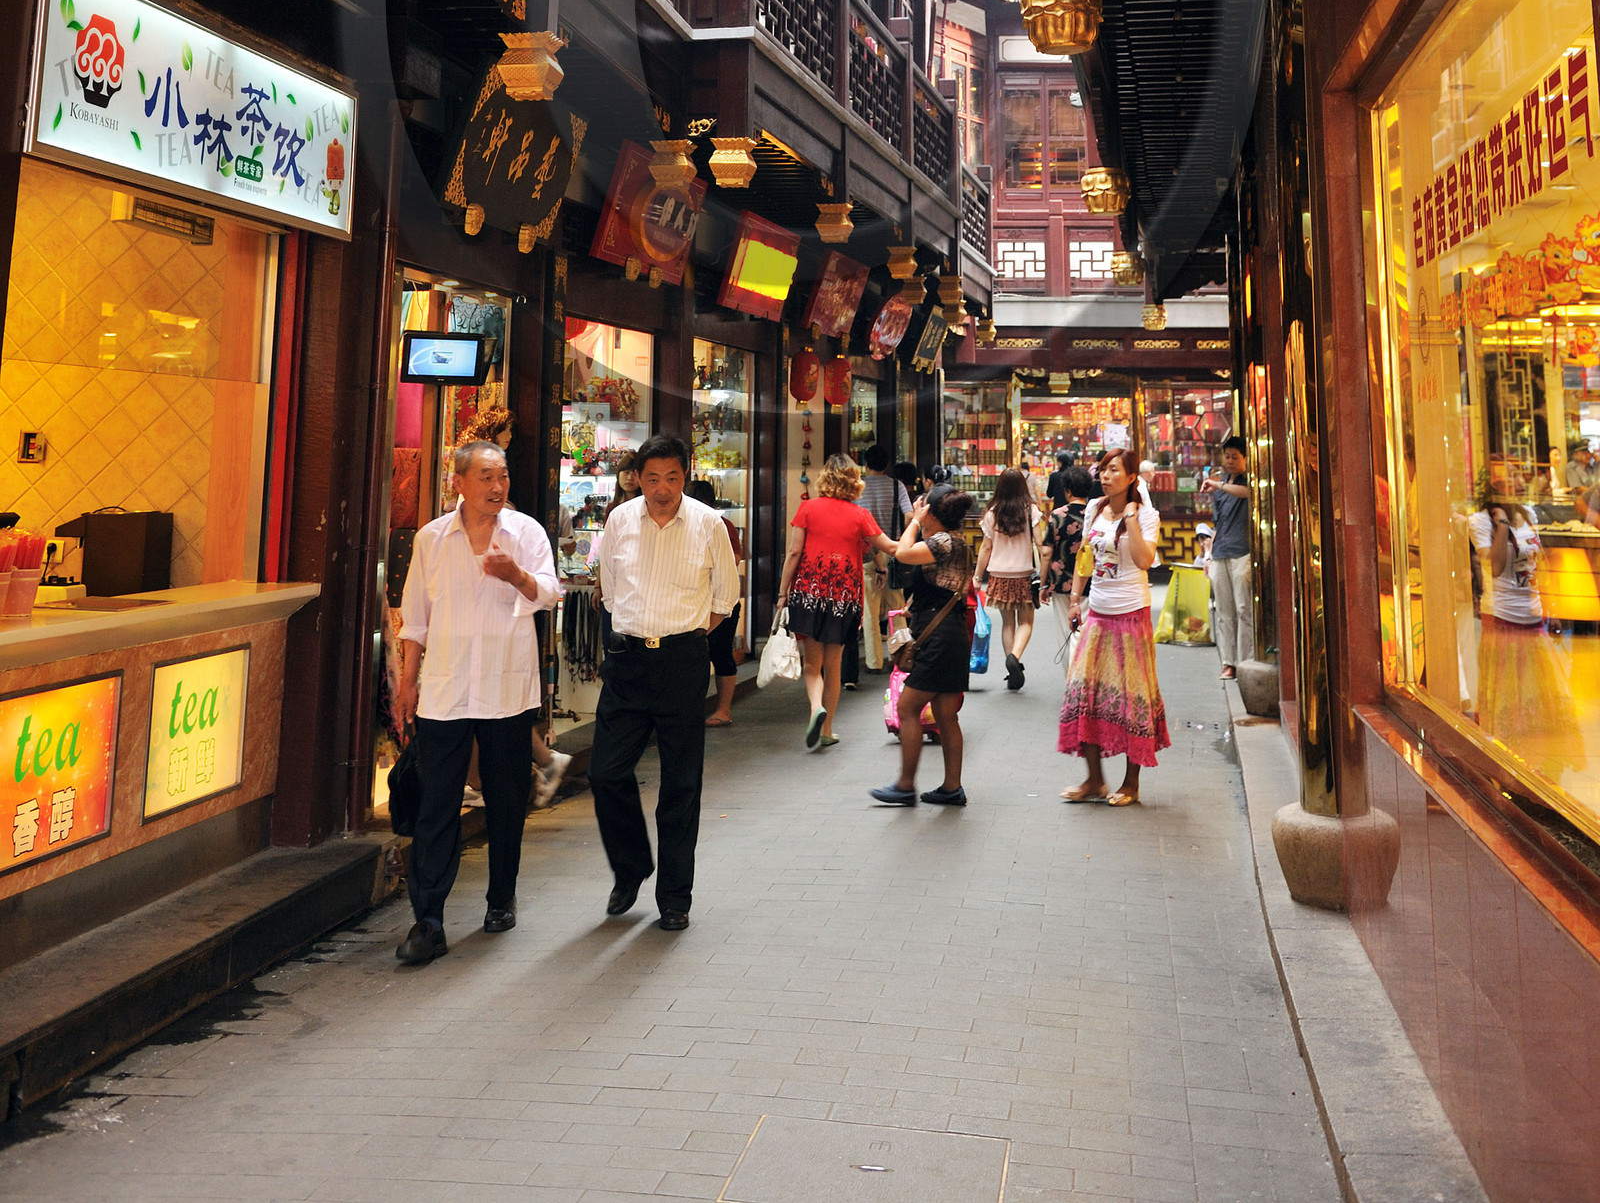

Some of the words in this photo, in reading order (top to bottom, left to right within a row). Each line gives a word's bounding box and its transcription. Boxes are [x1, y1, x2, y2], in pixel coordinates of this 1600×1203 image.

[205, 47, 235, 99] TEA
[144, 67, 305, 187] 小林茶饮
[155, 132, 192, 168] TEA
[313, 100, 340, 136] TEA
[1413, 45, 1594, 269] 老庙黄金给您带来好运气
[168, 680, 220, 739] tea
[14, 714, 82, 783] tea
[12, 786, 76, 858] 香醇
